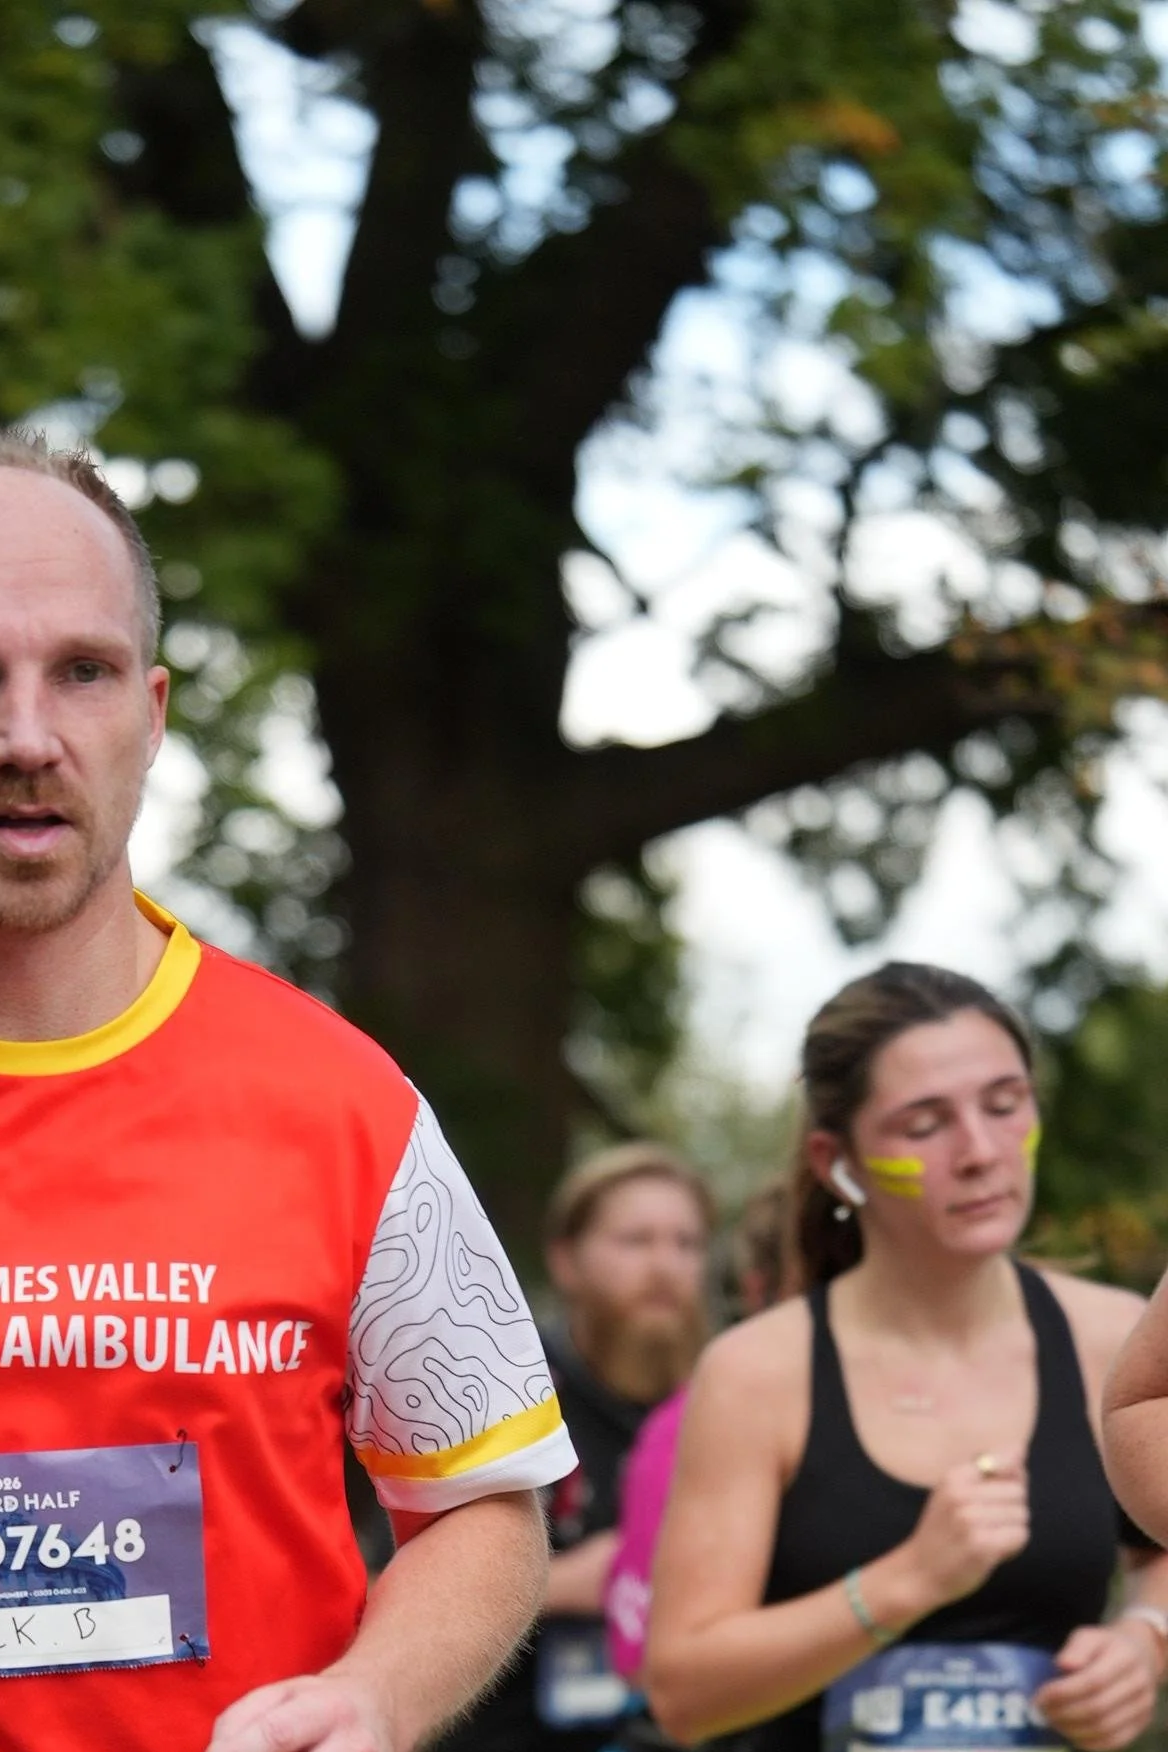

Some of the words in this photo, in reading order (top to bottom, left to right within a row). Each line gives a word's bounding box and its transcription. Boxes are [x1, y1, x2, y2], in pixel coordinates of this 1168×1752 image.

[67, 1263, 218, 1304] VALLEY
[0, 1314, 314, 1375] AMBULANCE
[24, 1490, 81, 1511] HALF
[73, 1607, 97, 1640] B
